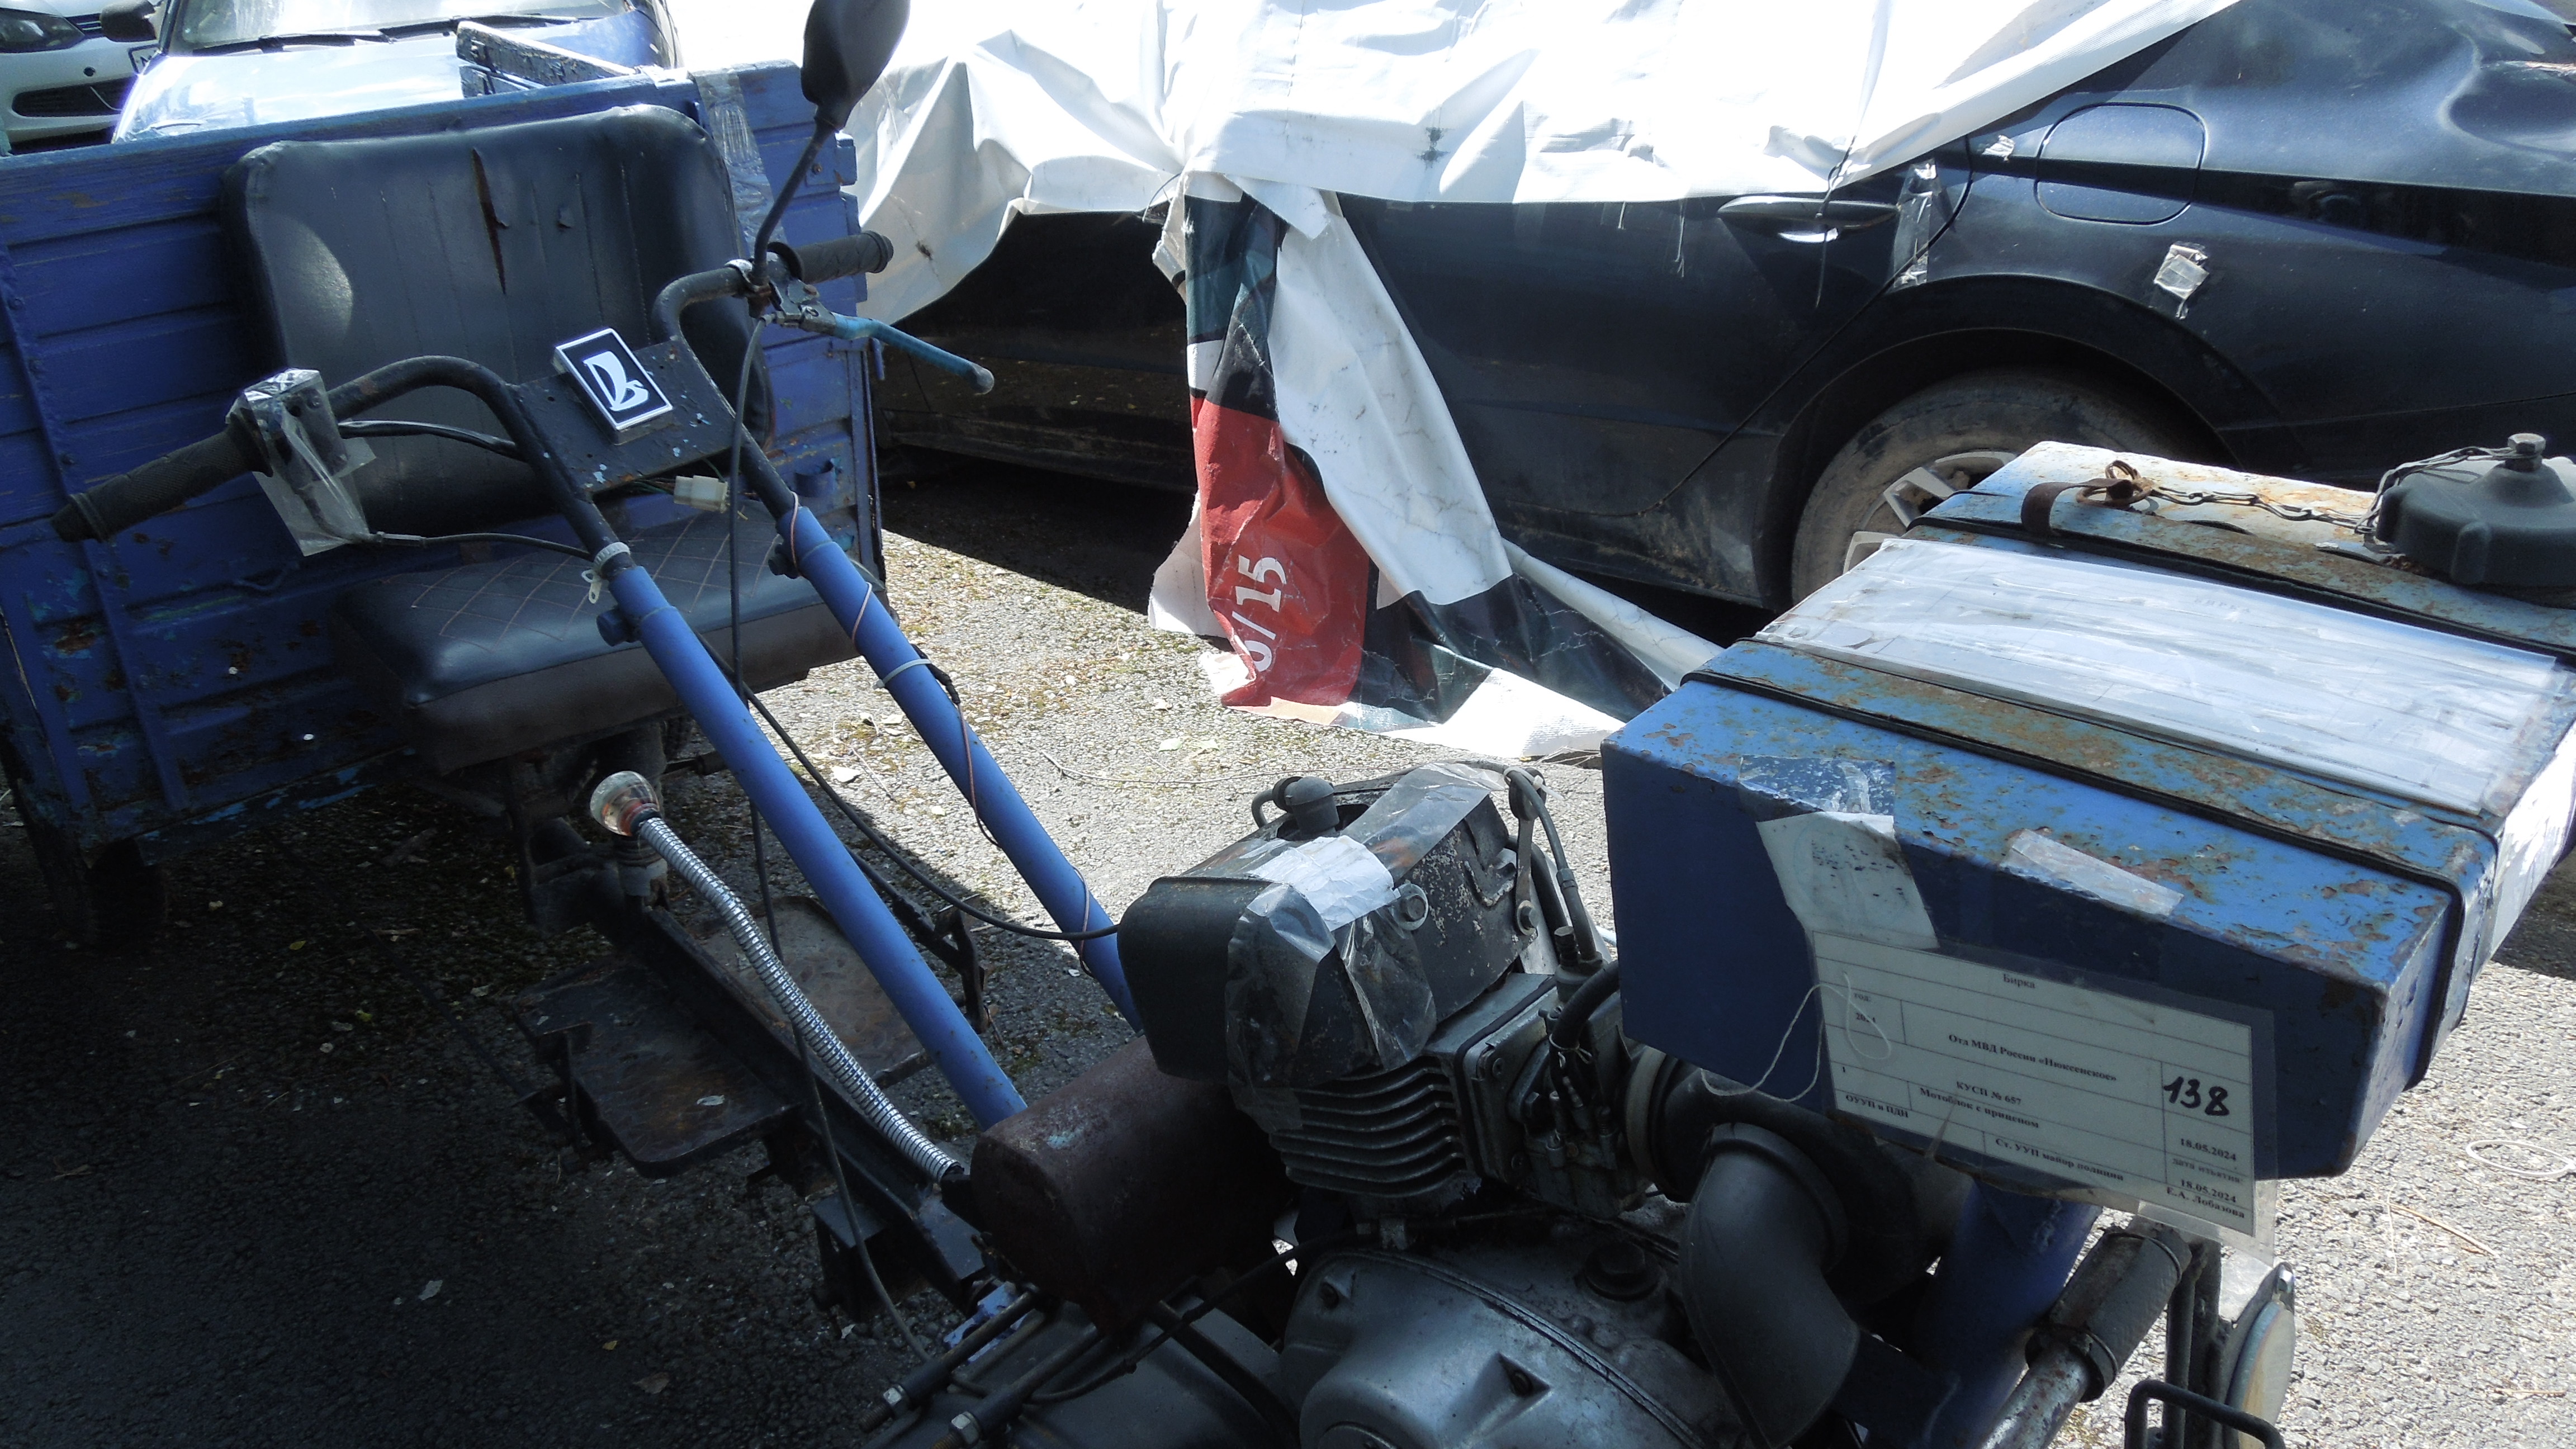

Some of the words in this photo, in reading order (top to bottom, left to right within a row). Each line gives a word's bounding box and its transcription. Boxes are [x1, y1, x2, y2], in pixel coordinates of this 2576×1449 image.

[2003, 974, 2036, 988] Бирка
[1949, 1034, 1969, 1046] Отд
[1971, 1039, 1997, 1054] МВД
[2000, 1046, 2036, 1062] России
[1957, 1081, 1987, 1096] КУСП
[2005, 1096, 2021, 1105] 657
[2163, 1076, 2230, 1116] 138
[1846, 1094, 1875, 1109] ОУУП
[1886, 1105, 1908, 1117] ПДН
[1920, 1088, 1973, 1110] Мотоблок
[1985, 1108, 2039, 1128] прицепом
[1996, 1138, 2012, 1149] Ст.
[2015, 1144, 2039, 1157] УУП
[2042, 1153, 2074, 1168] майор
[2077, 1164, 2124, 1181] полиции
[2180, 1138, 2236, 1161] 18.05.2024
[2180, 1179, 2236, 1202] 18.05.2024
